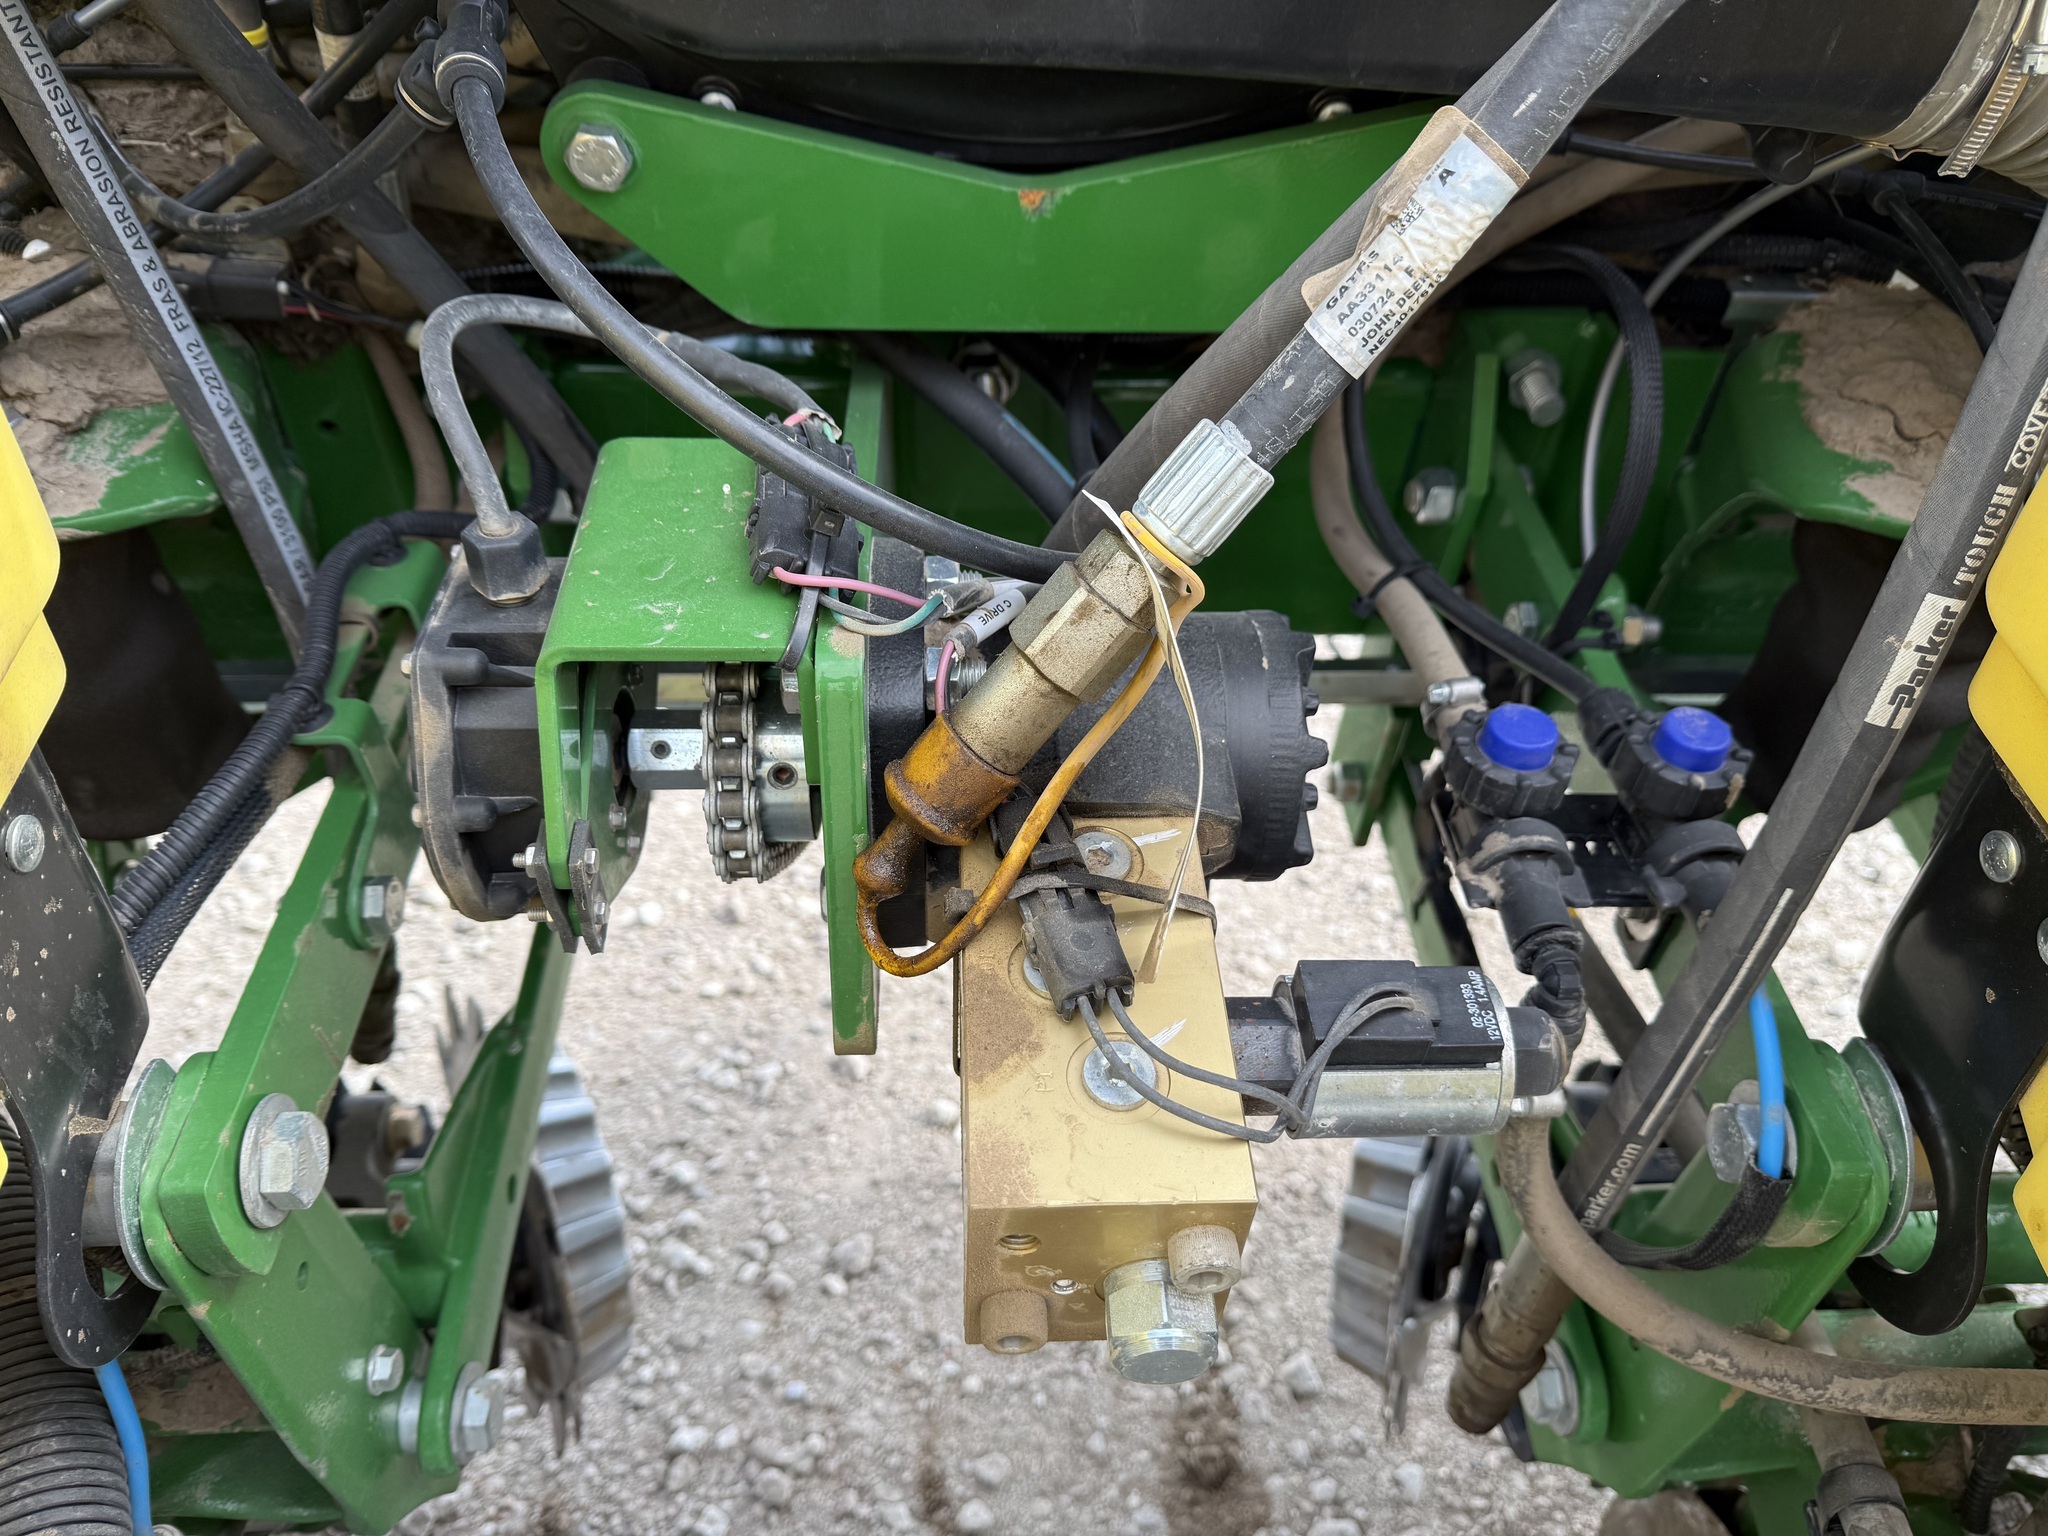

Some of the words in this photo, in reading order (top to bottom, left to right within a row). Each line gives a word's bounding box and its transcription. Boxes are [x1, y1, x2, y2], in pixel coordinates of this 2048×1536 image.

[0, 2, 82, 134] RESISTANT
[75, 138, 149, 251] ABRASION
[1438, 168, 1457, 188] A
[141, 256, 158, 273] &
[153, 277, 190, 333] FRAS
[1336, 253, 1404, 326] AA33114
[1347, 287, 1396, 338] 030724
[1361, 308, 1396, 348] JOHN
[186, 338, 233, 418] IC-227/12
[228, 416, 260, 471] MSHA
[978, 603, 1005, 626] DRIVE
[1003, 599, 1012, 608] C
[1886, 603, 1959, 722] Parker
[1952, 484, 2018, 586] TOUGH
[1459, 983, 1485, 1028] 02-301393
[1467, 970, 1490, 1002] 1.4AMP
[1481, 1009, 1502, 1041] 12VDC
